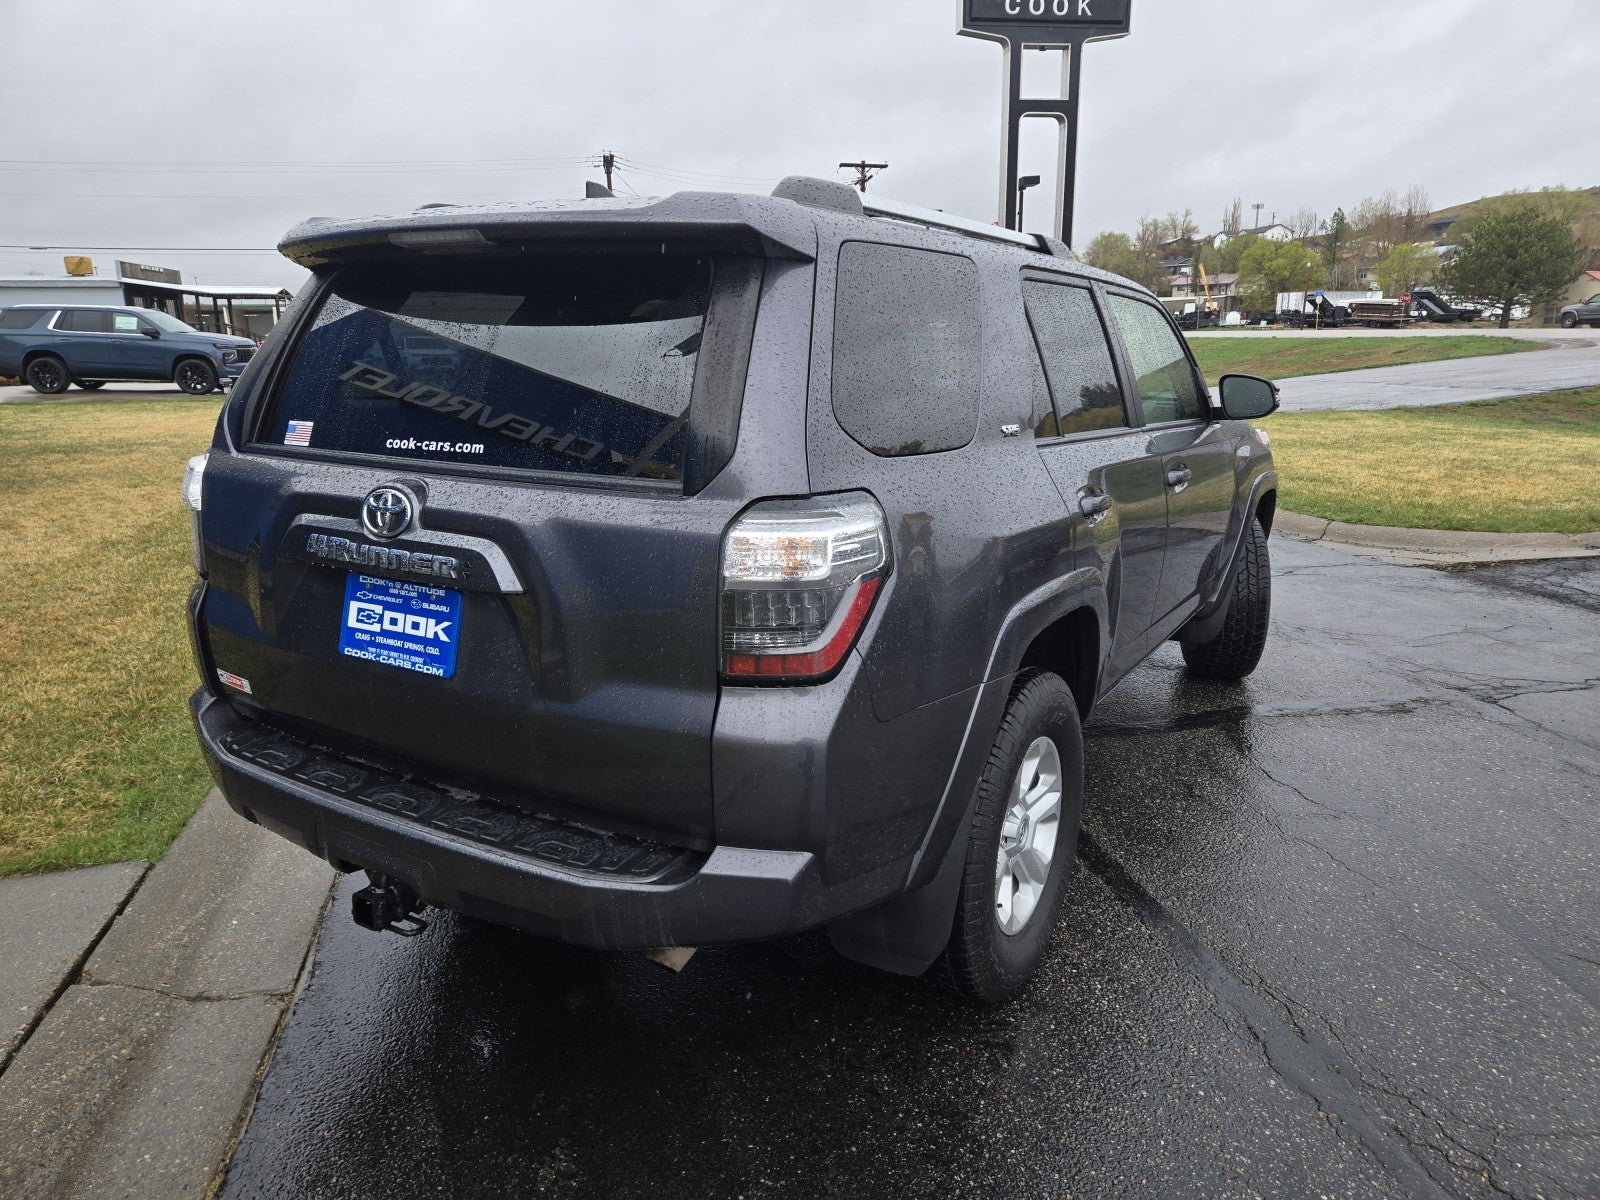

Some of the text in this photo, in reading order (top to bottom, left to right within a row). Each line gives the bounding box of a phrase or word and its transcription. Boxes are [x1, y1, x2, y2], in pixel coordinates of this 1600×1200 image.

[1005, 0, 1093, 16] COOK
[386, 435, 485, 455] cook-cars.com
[306, 533, 458, 579] 4RUNNER
[403, 583, 446, 597] ALTITUDE
[373, 594, 404, 604] CHEVROLET
[422, 602, 450, 613] SUBARU
[347, 600, 453, 643] COOK
[355, 632, 371, 641] CRAIG
[375, 635, 404, 648] STEAMBOAT
[344, 647, 444, 677] COOK-CARS.COM
